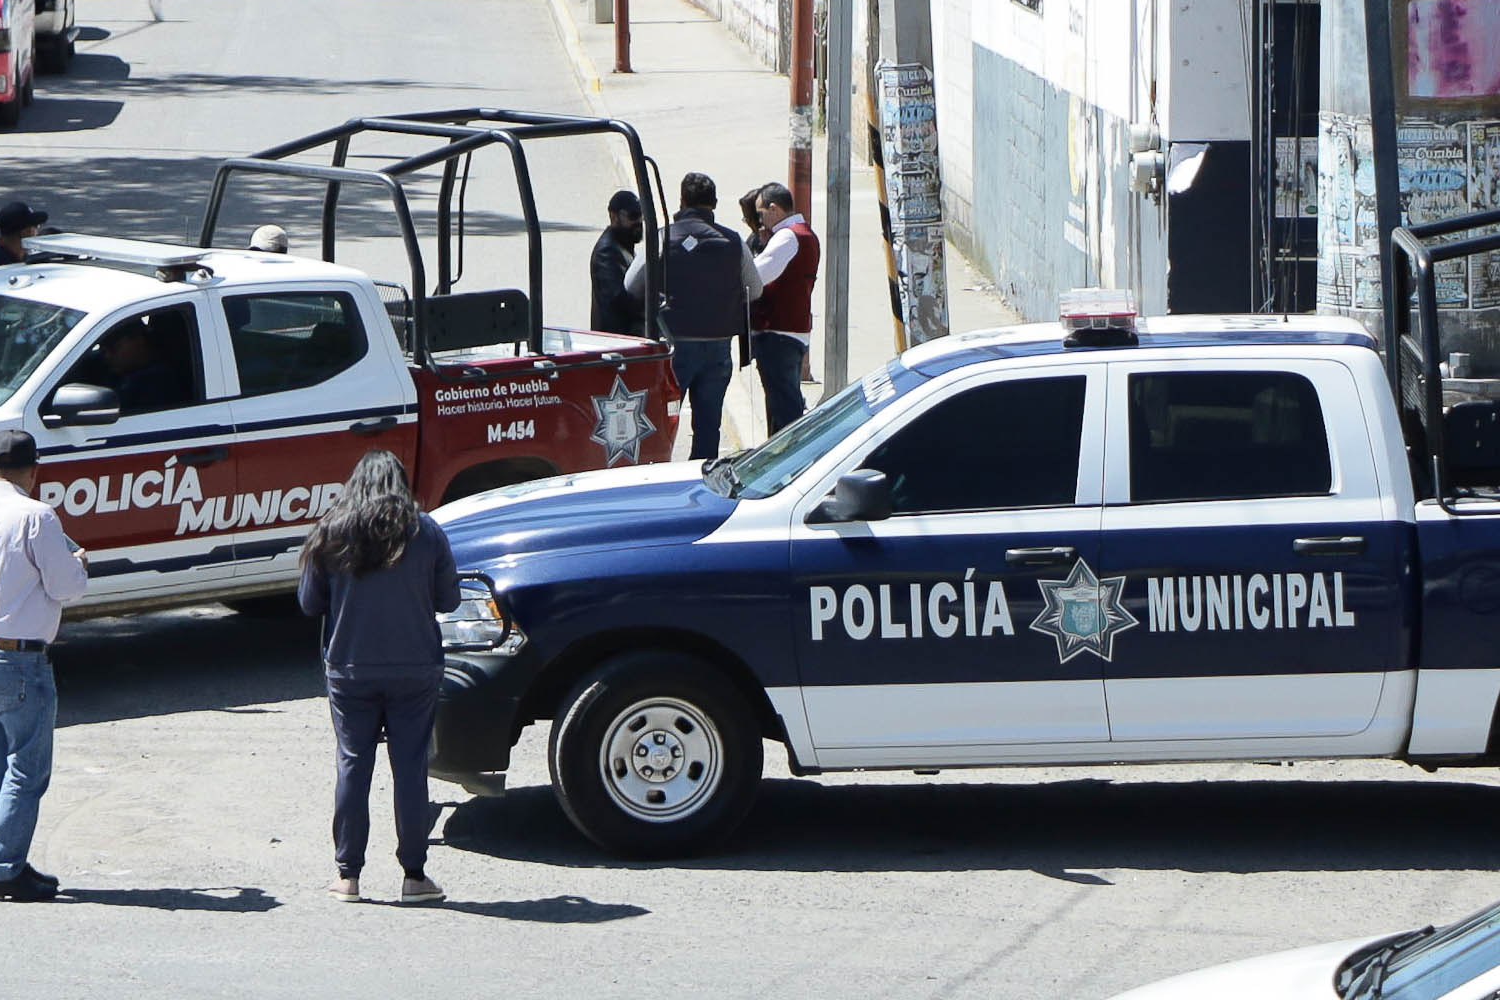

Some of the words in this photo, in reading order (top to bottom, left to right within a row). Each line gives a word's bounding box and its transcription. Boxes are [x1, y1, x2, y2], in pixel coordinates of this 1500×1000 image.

[1415, 146, 1464, 160] Cumbia
[435, 385, 490, 402] Gobierno
[493, 383, 507, 396] de
[509, 379, 550, 394] Puebla
[437, 405, 466, 416] Hacer
[506, 397, 533, 408] Hacer
[487, 419, 536, 443] M-454
[38, 455, 203, 518] POLICÍA
[175, 481, 348, 536] MUNICIP
[809, 567, 1016, 641] POLICÍA
[1147, 571, 1356, 632] MUNICIPAL
